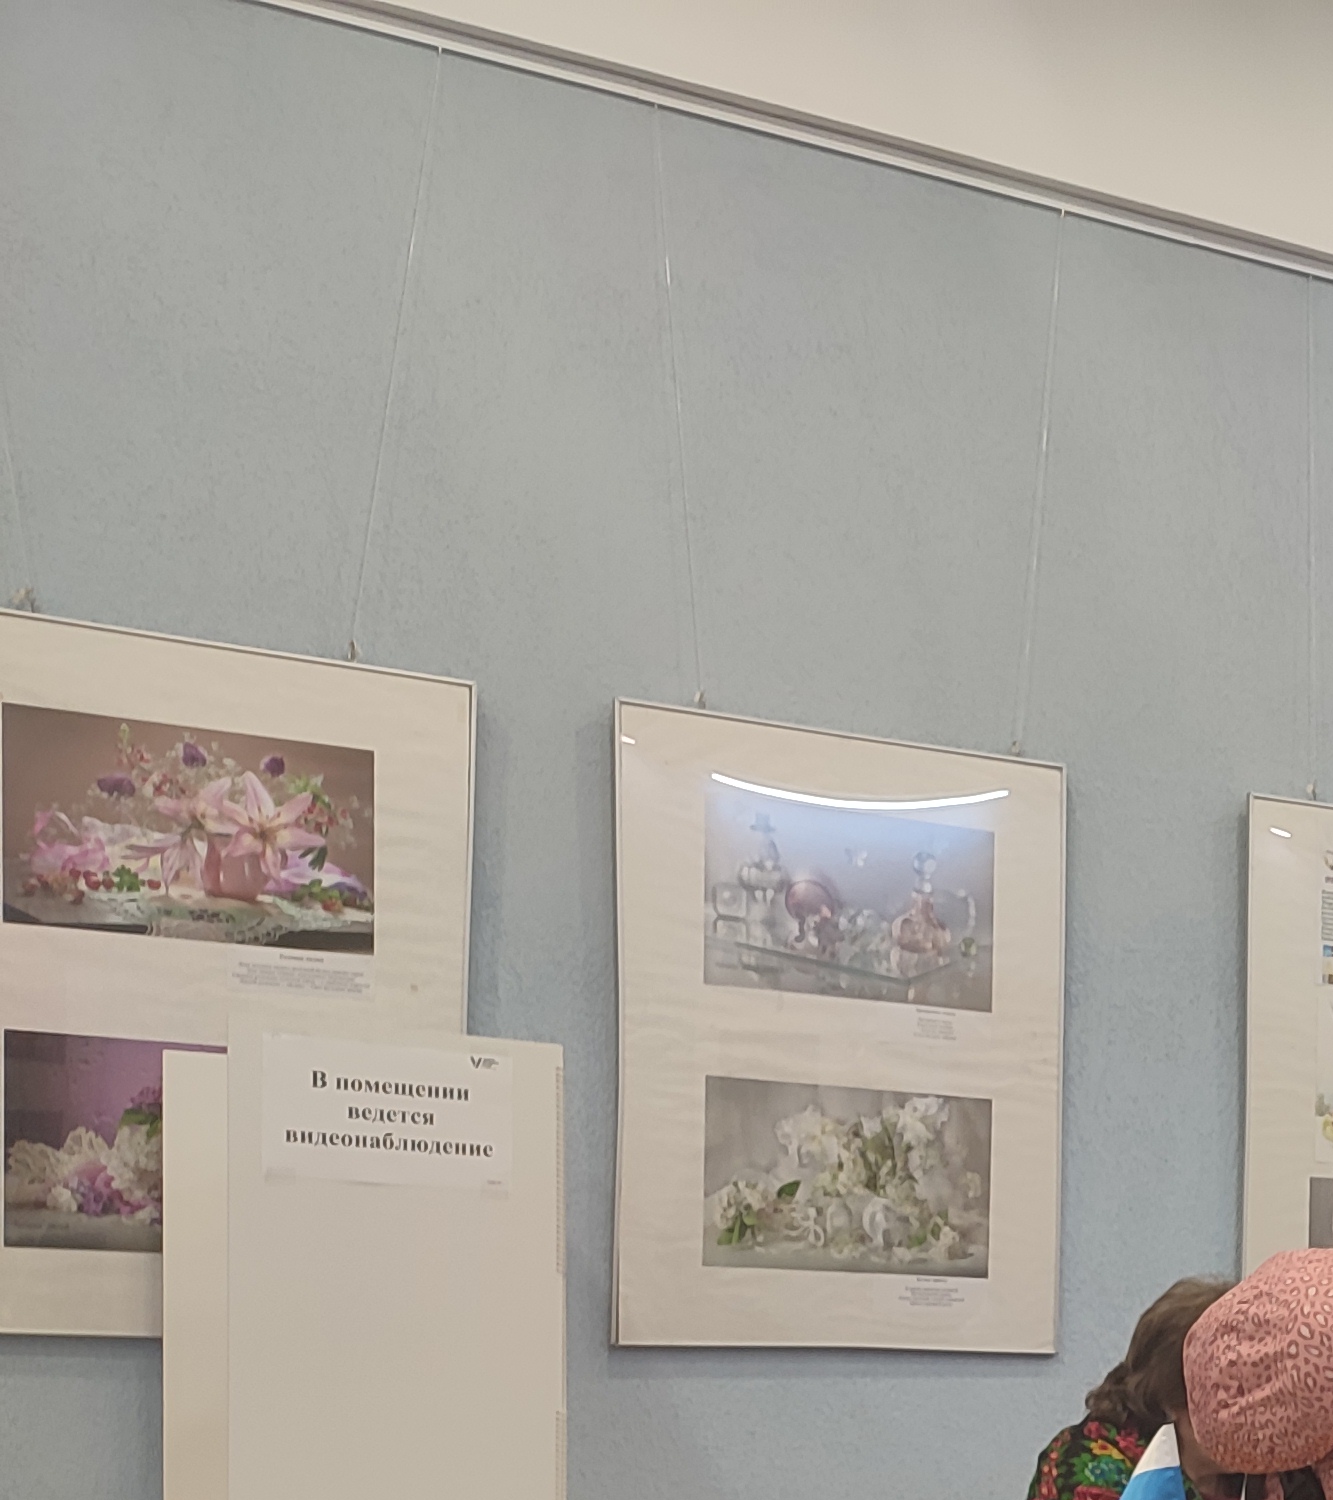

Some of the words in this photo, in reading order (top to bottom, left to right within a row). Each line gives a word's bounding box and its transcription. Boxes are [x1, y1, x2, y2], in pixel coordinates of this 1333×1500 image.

[312, 1070, 327, 1089] В
[336, 1076, 470, 1101] помещении
[348, 1105, 435, 1126] ведется
[285, 1129, 494, 1158] видеонаблюдение
